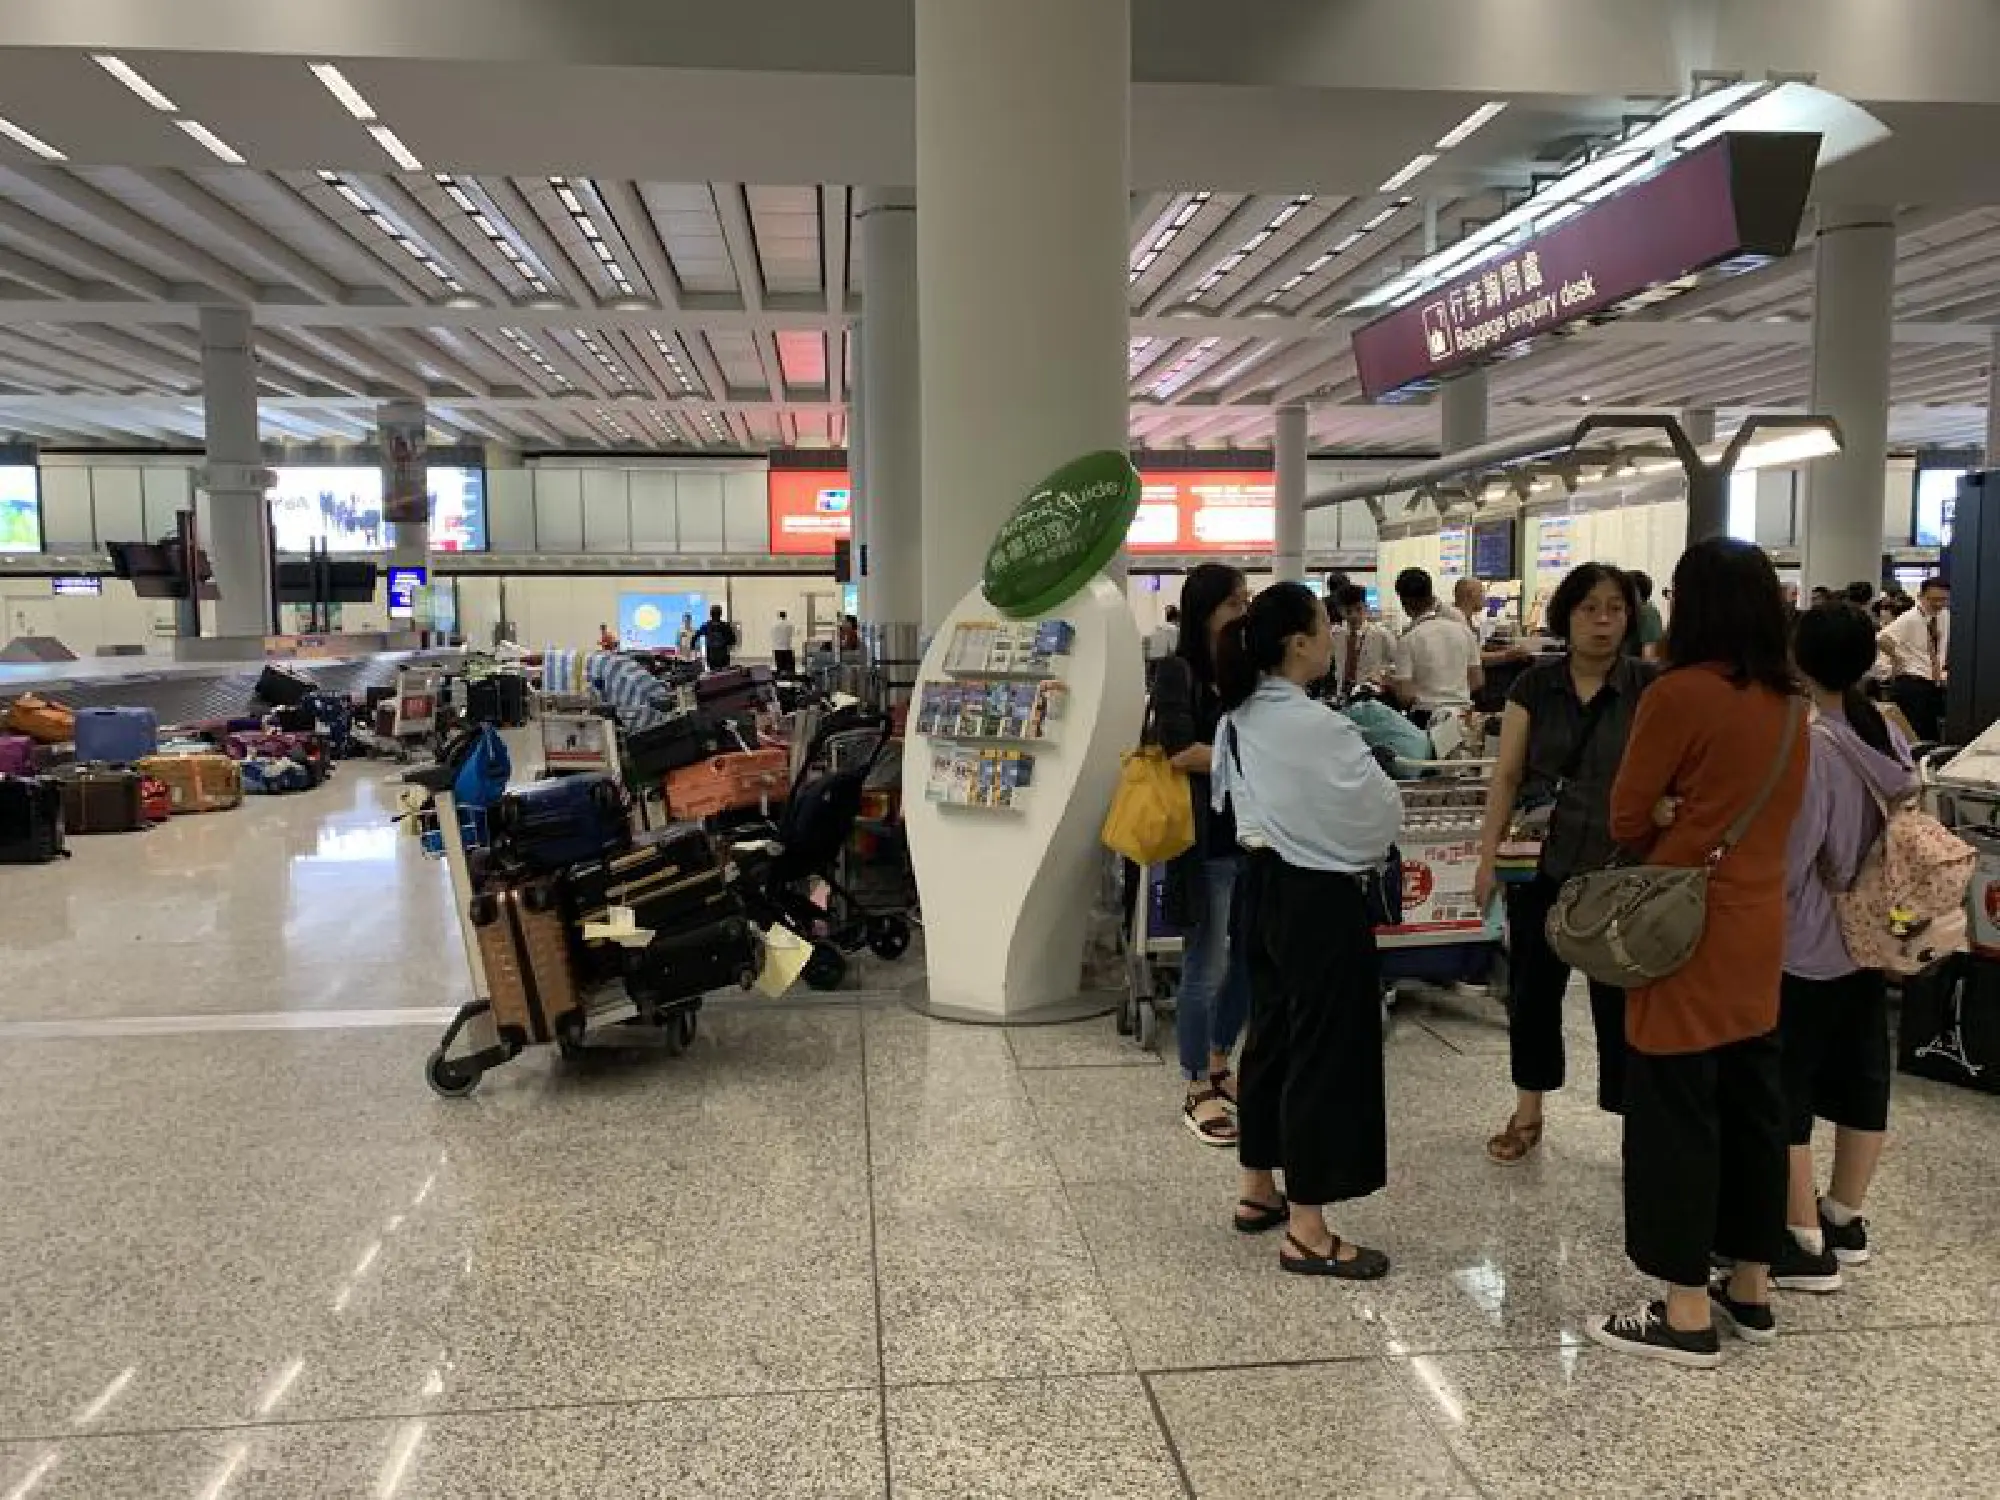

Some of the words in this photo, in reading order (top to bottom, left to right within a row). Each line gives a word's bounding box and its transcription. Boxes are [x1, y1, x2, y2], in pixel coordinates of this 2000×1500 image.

[1454, 314, 1506, 351] Baggage
[1507, 291, 1558, 330] enquiry
[1559, 269, 1596, 308] desk
